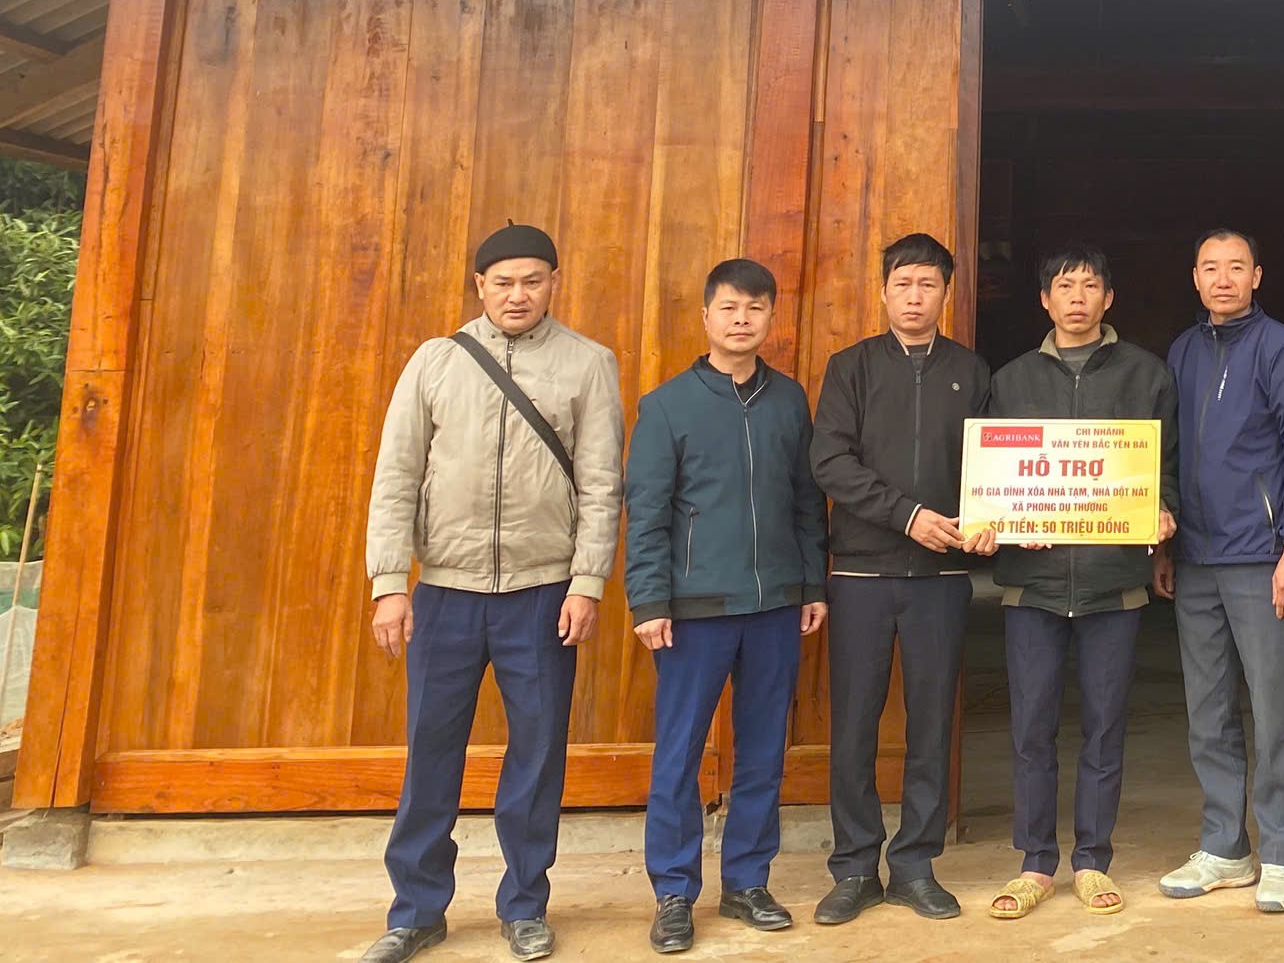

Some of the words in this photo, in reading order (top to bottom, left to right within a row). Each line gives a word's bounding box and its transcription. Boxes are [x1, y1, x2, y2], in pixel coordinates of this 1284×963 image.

[993, 433, 1041, 442] AGRIBANK
[1075, 428, 1091, 436] CHI
[1093, 427, 1125, 436] NHÁNH
[1051, 439, 1070, 448] VĂN
[1072, 439, 1090, 448] YÊN
[1113, 439, 1130, 448] YÊN
[1018, 453, 1050, 477] HỖ
[1058, 458, 1104, 481] TRỢ
[971, 485, 984, 499] HỘ
[986, 487, 1001, 496] GIA
[1003, 485, 1025, 496] ĐÌNH
[1027, 485, 1045, 496] XÓA
[1047, 485, 1066, 496] NHÀ
[1068, 487, 1090, 499] TẠM,
[1092, 486, 1110, 496] NHÀ
[1012, 500, 1024, 512] XÃ
[1026, 502, 1057, 512] PHONG
[1073, 501, 1108, 514] THƯỢNG
[989, 516, 1006, 534] SỐ
[1042, 520, 1057, 534] 50
[1060, 518, 1094, 537] TRIỆU
